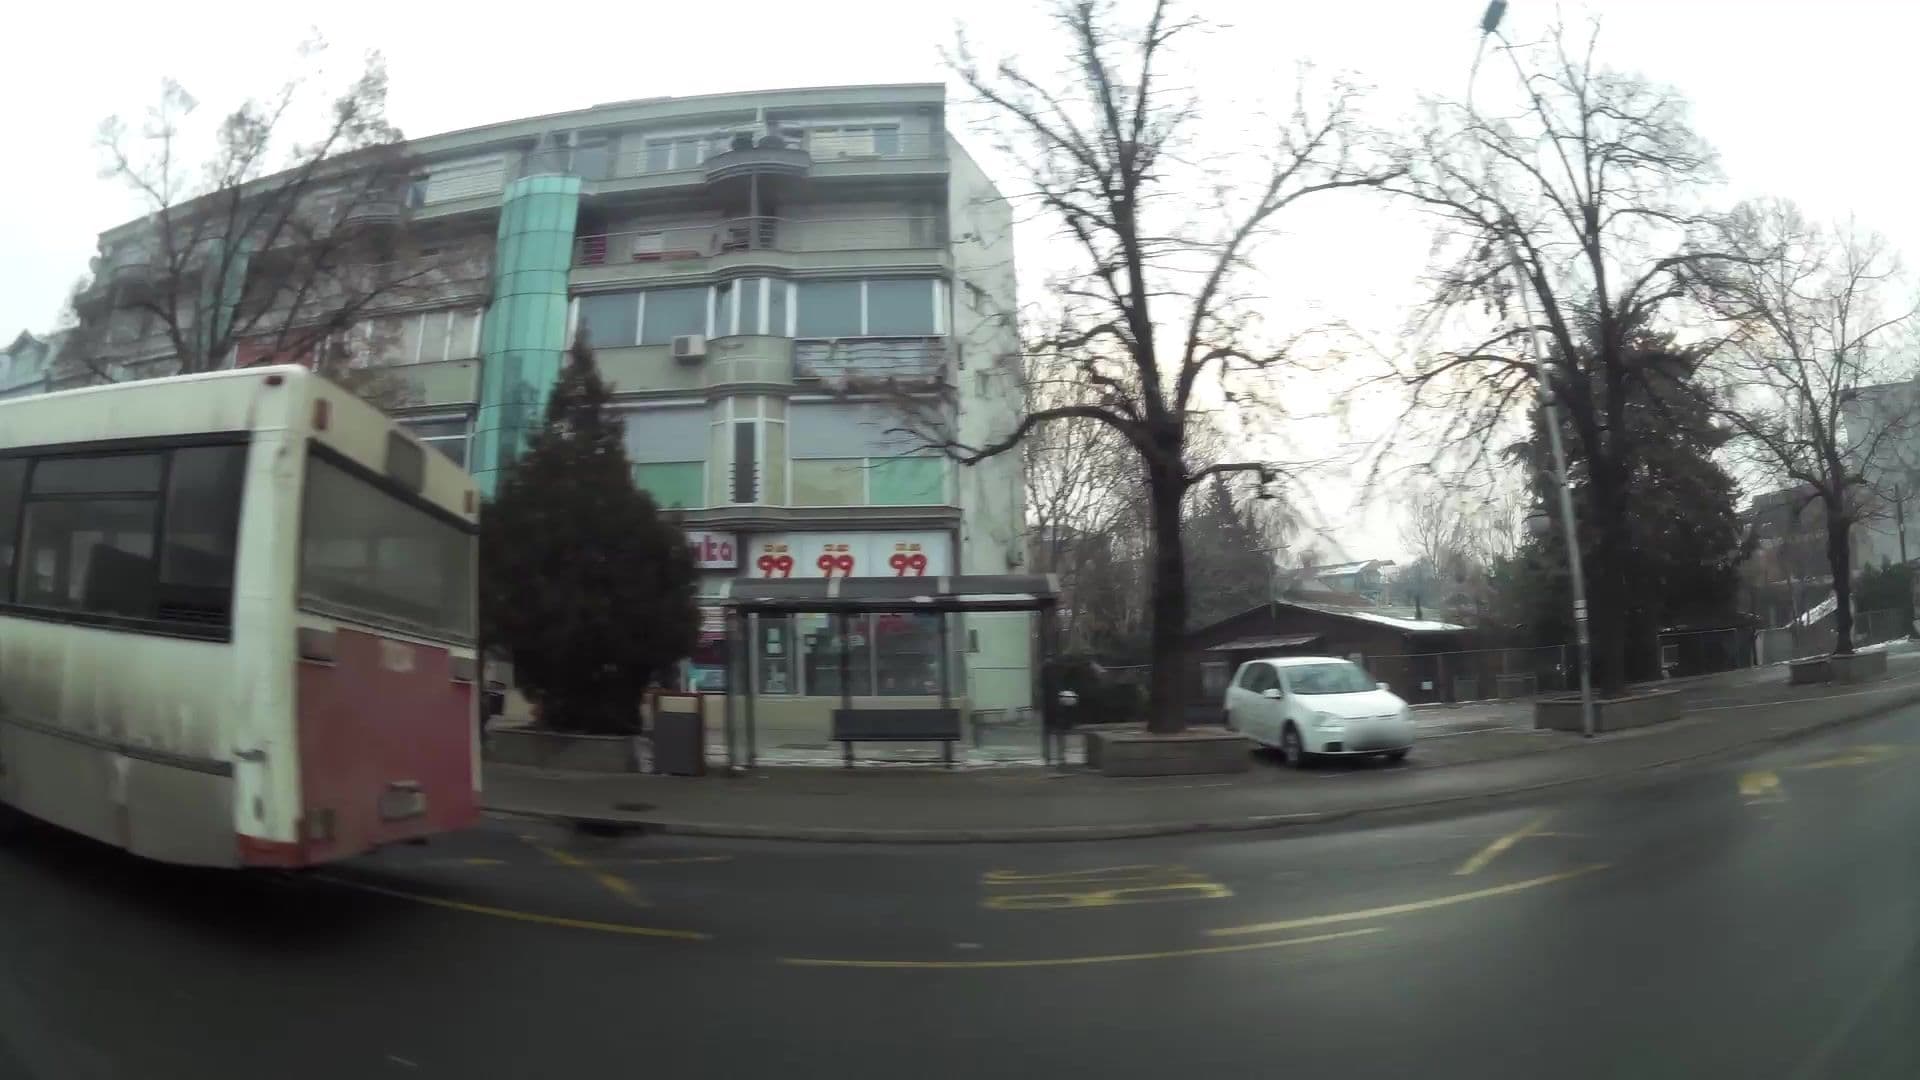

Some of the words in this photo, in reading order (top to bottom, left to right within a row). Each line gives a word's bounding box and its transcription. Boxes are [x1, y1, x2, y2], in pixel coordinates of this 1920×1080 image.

[757, 554, 795, 578] 99
[817, 554, 854, 577] 99
[889, 553, 927, 576] 99
